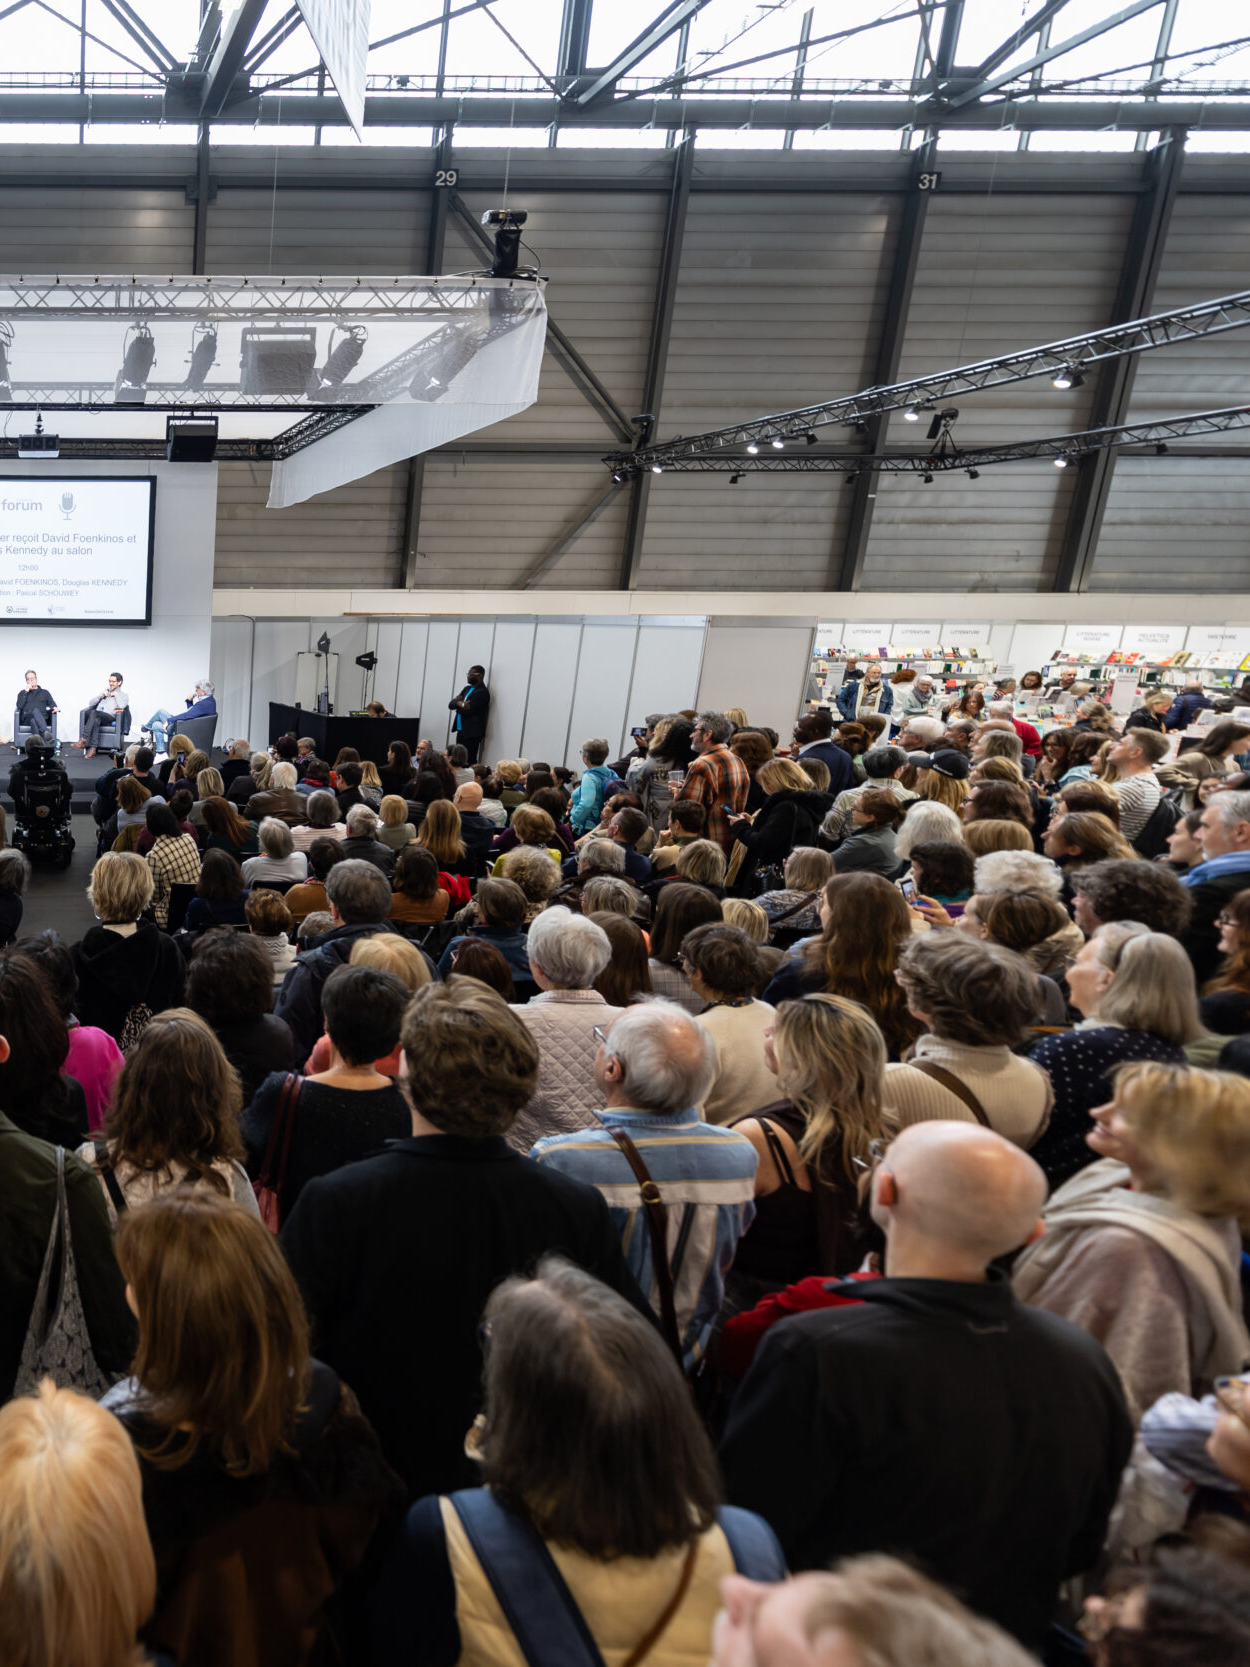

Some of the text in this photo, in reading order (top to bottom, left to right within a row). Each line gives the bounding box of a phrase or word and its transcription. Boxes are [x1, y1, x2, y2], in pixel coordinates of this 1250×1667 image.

[435, 170, 457, 186] 29
[918, 173, 938, 189] 31
[1, 499, 43, 511] forum
[12, 533, 40, 545] reçoit
[42, 533, 70, 543] David
[73, 533, 125, 543] Foenkinos
[127, 534, 137, 544] et
[5, 545, 48, 557] Kennedy
[51, 547, 64, 555] au
[66, 545, 93, 556] salon
[15, 579, 61, 587] FOENKINOS,
[62, 579, 90, 588] Douglas
